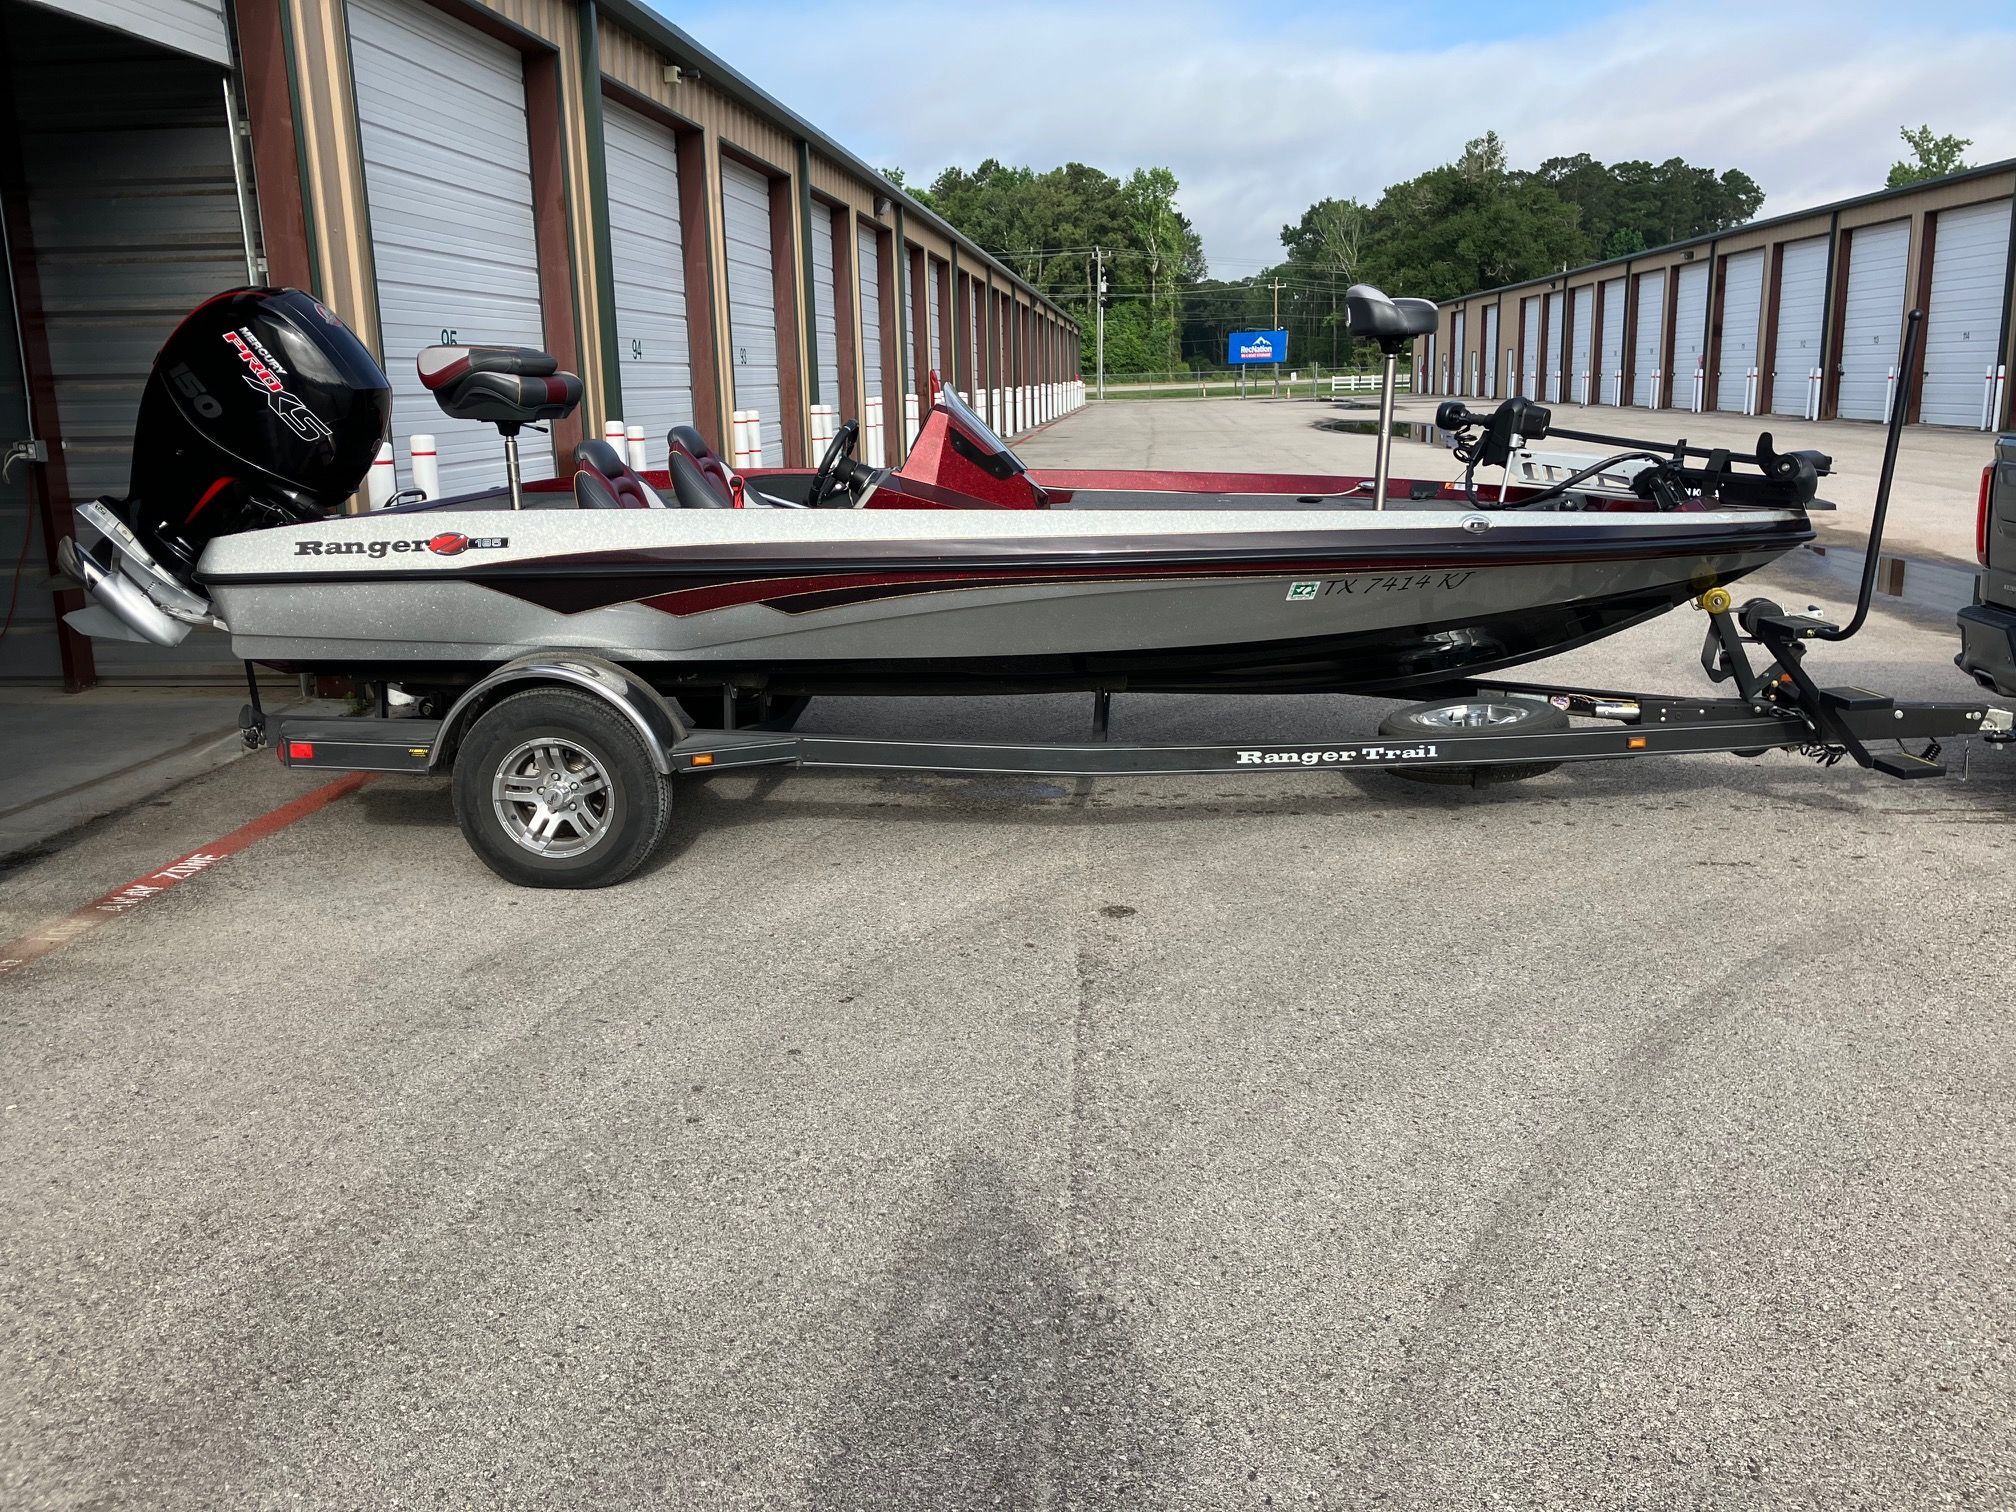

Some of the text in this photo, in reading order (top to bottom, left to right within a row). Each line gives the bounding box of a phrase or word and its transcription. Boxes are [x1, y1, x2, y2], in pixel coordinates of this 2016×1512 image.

[222, 331, 284, 392] PRO
[238, 326, 288, 375] MERCURY
[632, 339, 642, 360] 94
[739, 347, 747, 365] 93
[169, 362, 223, 418] 150
[241, 375, 333, 441] XS
[294, 539, 430, 559] Ranger
[1324, 578, 1358, 596] TX
[1363, 574, 1432, 594] 7414
[1437, 571, 1476, 590] KJ
[1236, 745, 1438, 766] Ranger Trail
[152, 853, 228, 880] ZONE
